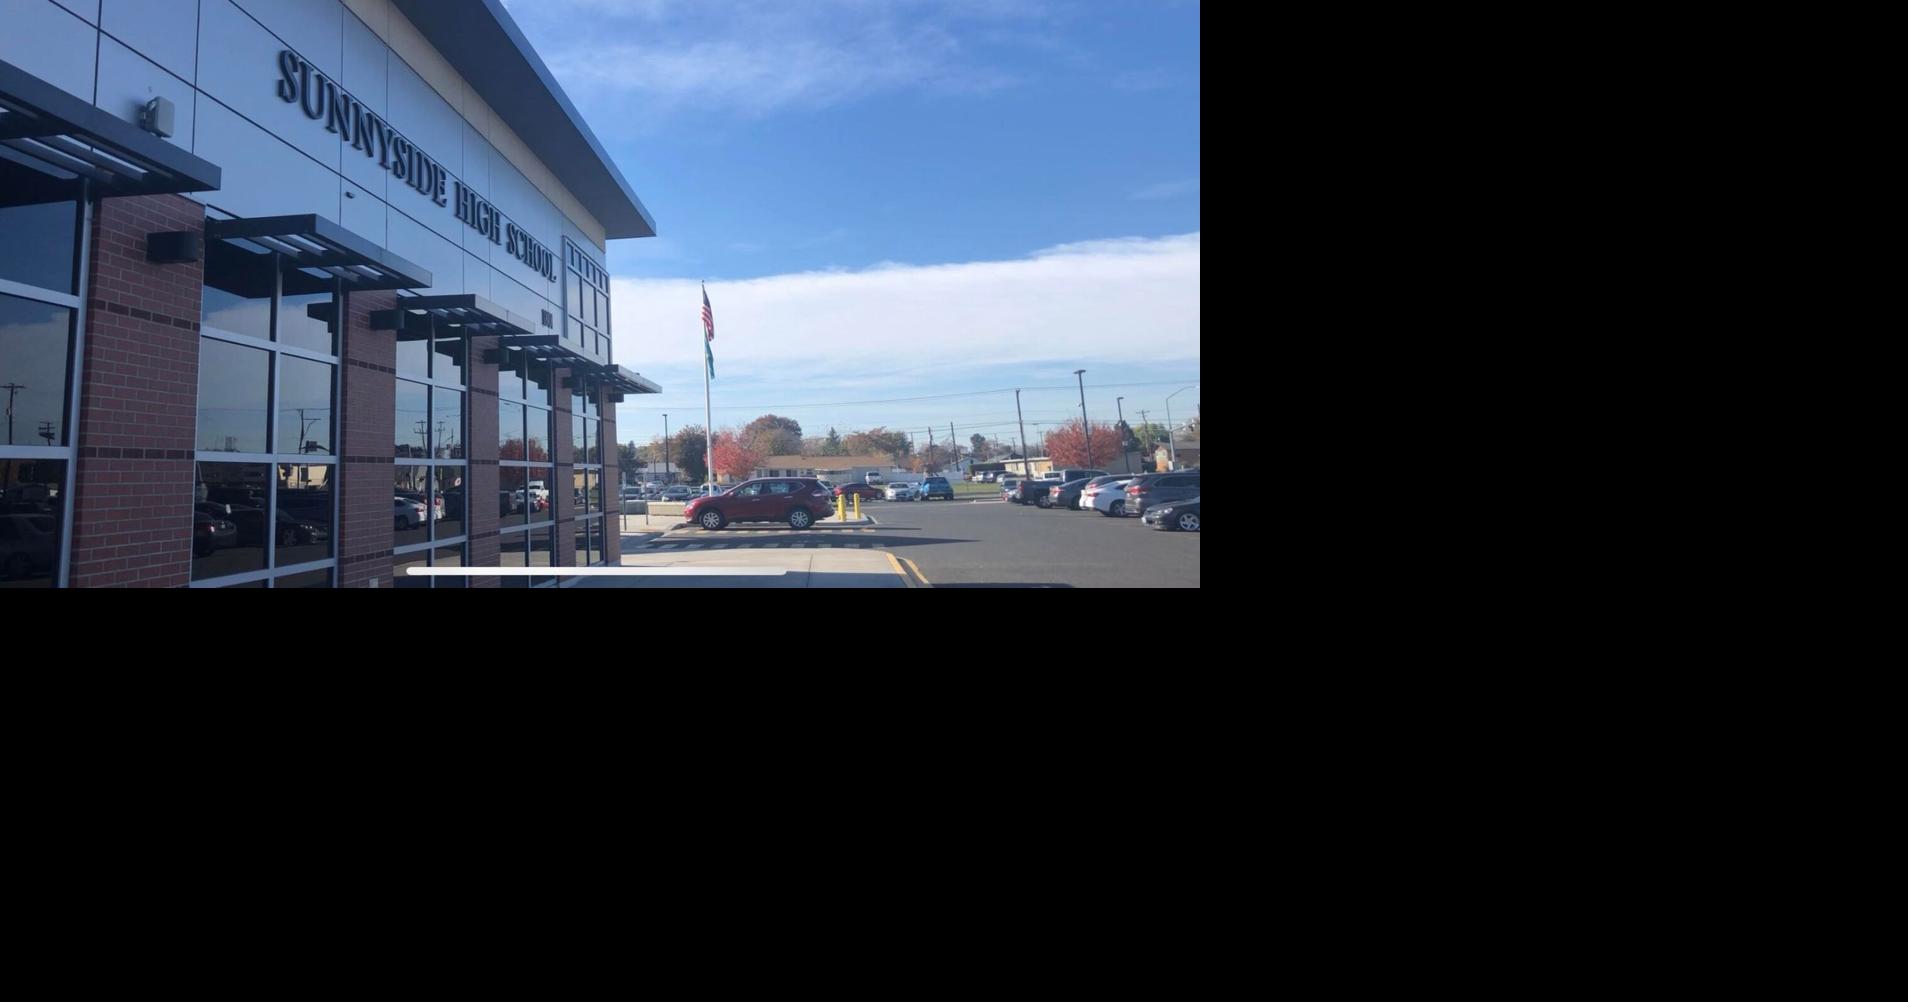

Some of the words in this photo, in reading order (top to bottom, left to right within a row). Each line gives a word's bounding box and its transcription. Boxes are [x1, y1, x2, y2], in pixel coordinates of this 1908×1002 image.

[276, 49, 448, 208] SUNNYSIDE
[453, 180, 502, 246] HIGH
[505, 222, 557, 283] SCHOOL
